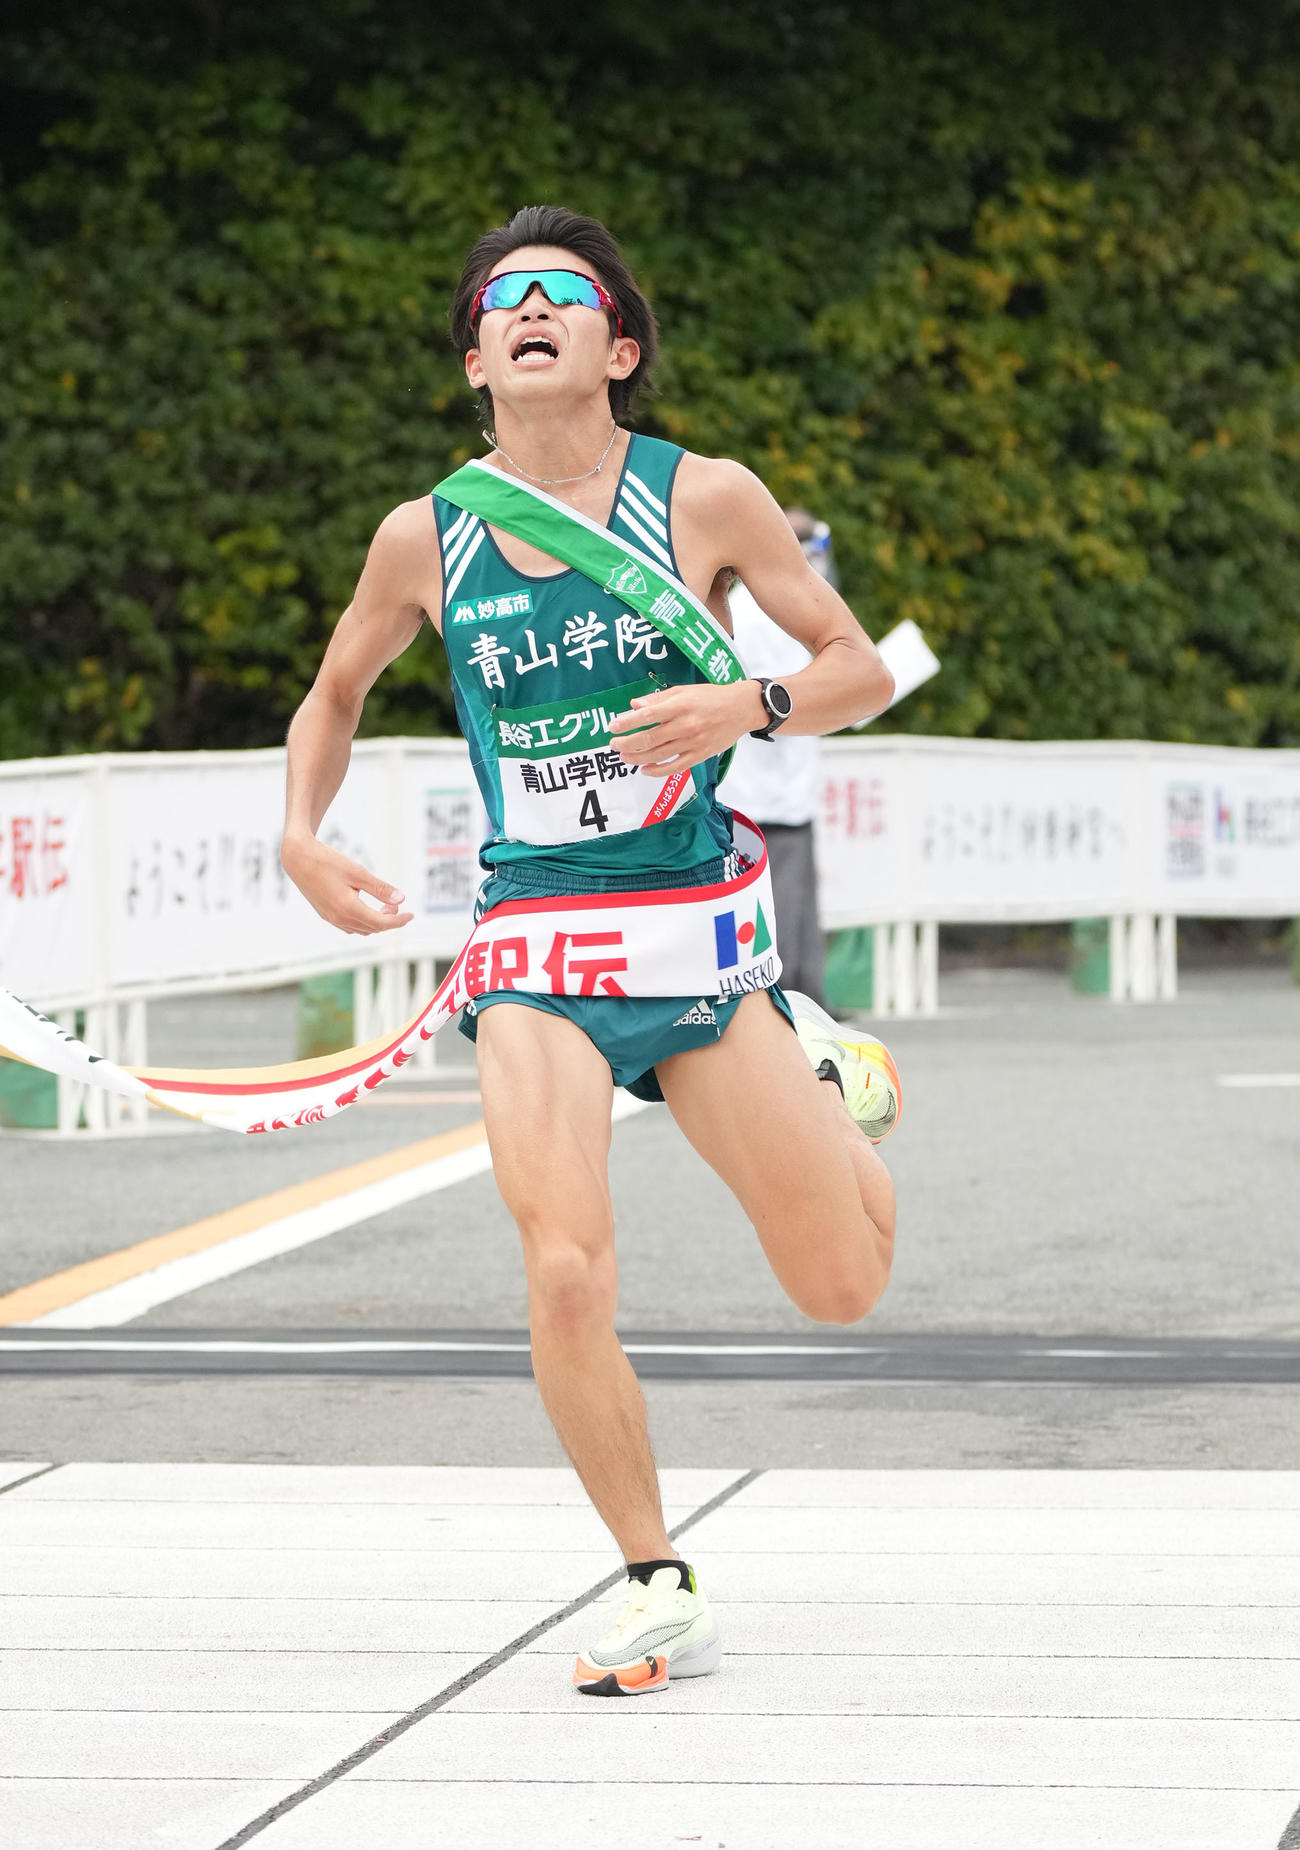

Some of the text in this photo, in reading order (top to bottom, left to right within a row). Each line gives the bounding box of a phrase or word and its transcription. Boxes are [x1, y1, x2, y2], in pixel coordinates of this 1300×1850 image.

[477, 593, 530, 620] 妙高市
[467, 611, 668, 689] 青山学院
[649, 588, 743, 683] 青山学
[520, 750, 640, 794] 青山学院
[579, 789, 608, 833] 4
[464, 930, 629, 998] 駅伝
[719, 956, 775, 996] HASEKO
